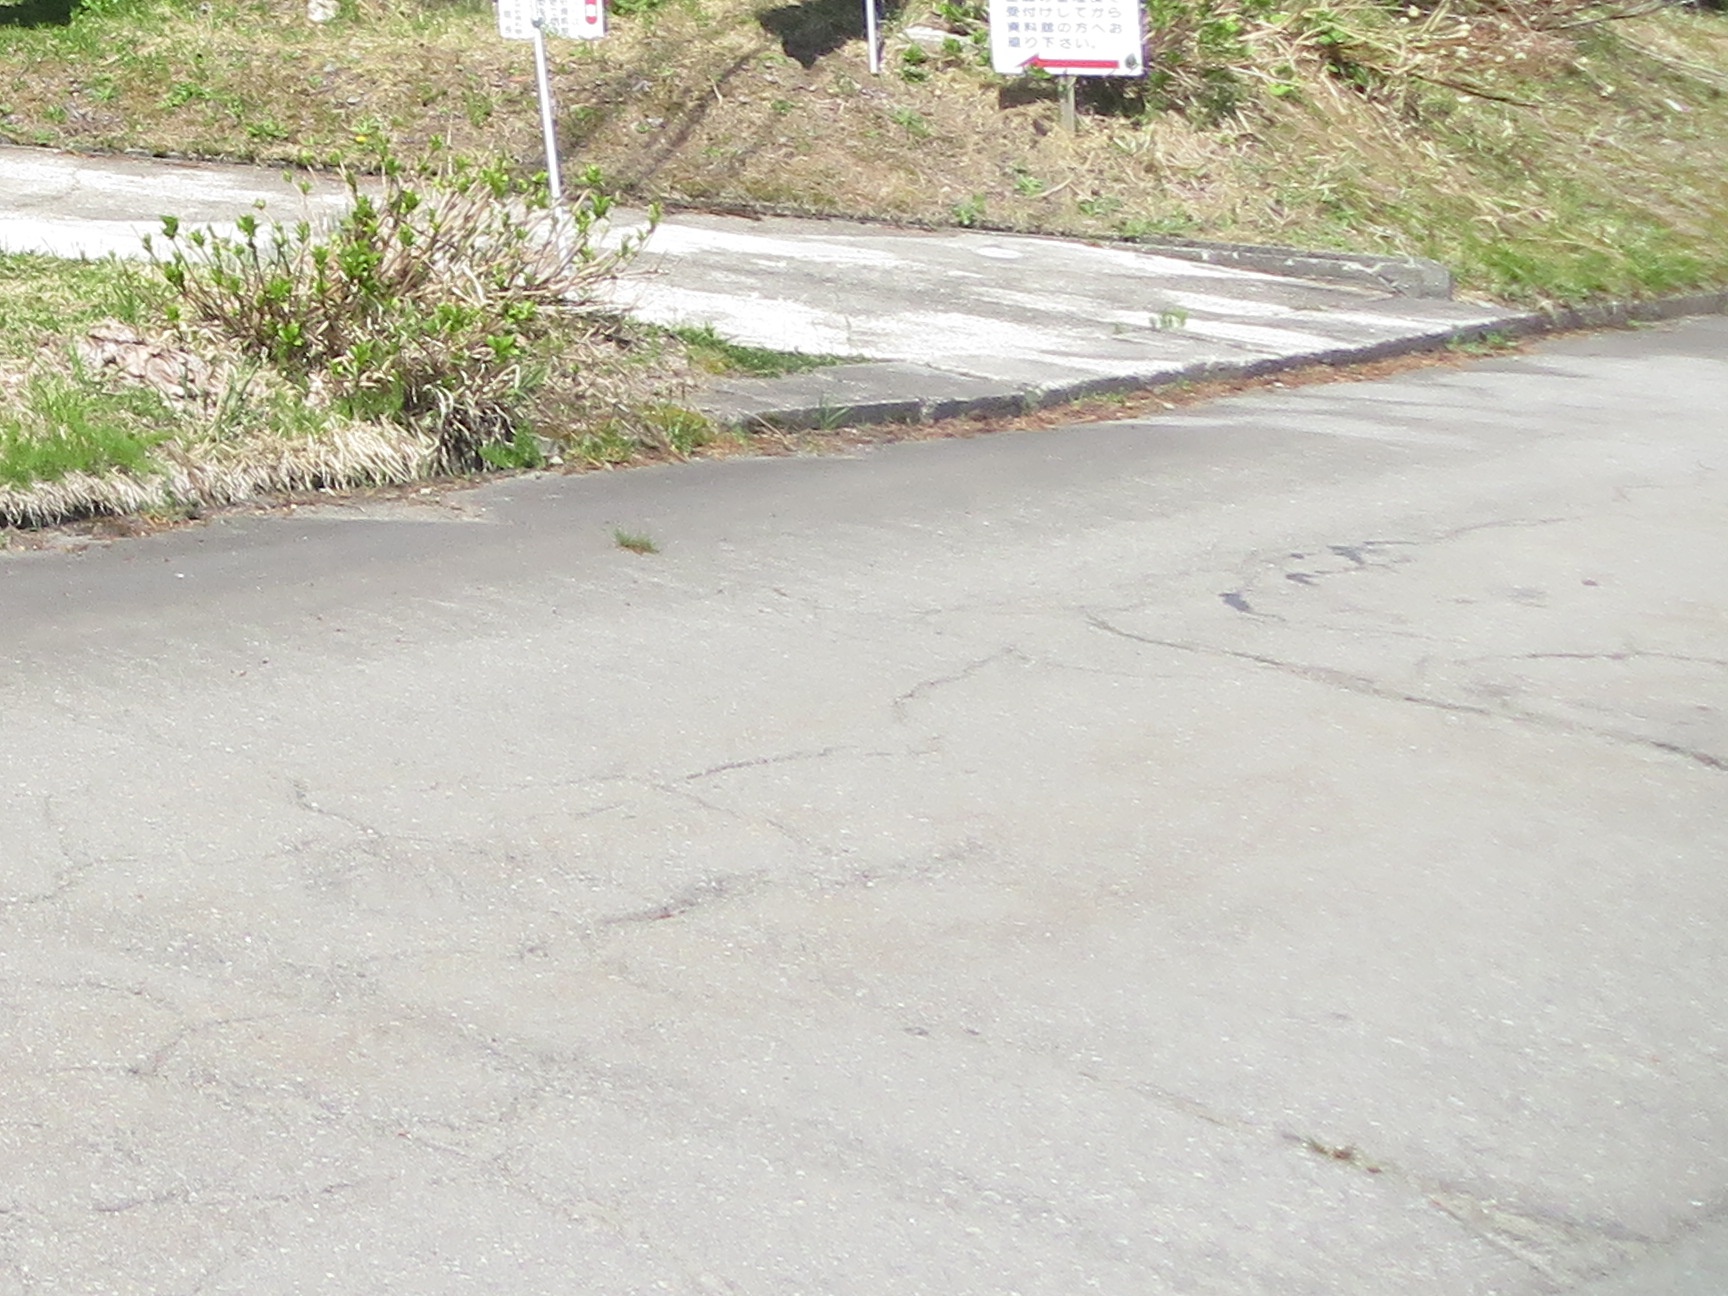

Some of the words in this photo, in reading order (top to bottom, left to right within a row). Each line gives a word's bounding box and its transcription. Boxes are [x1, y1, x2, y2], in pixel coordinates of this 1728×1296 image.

[1006, 6, 1122, 19] 受付けしてから
[1007, 21, 1123, 34] 資料館の方へお
